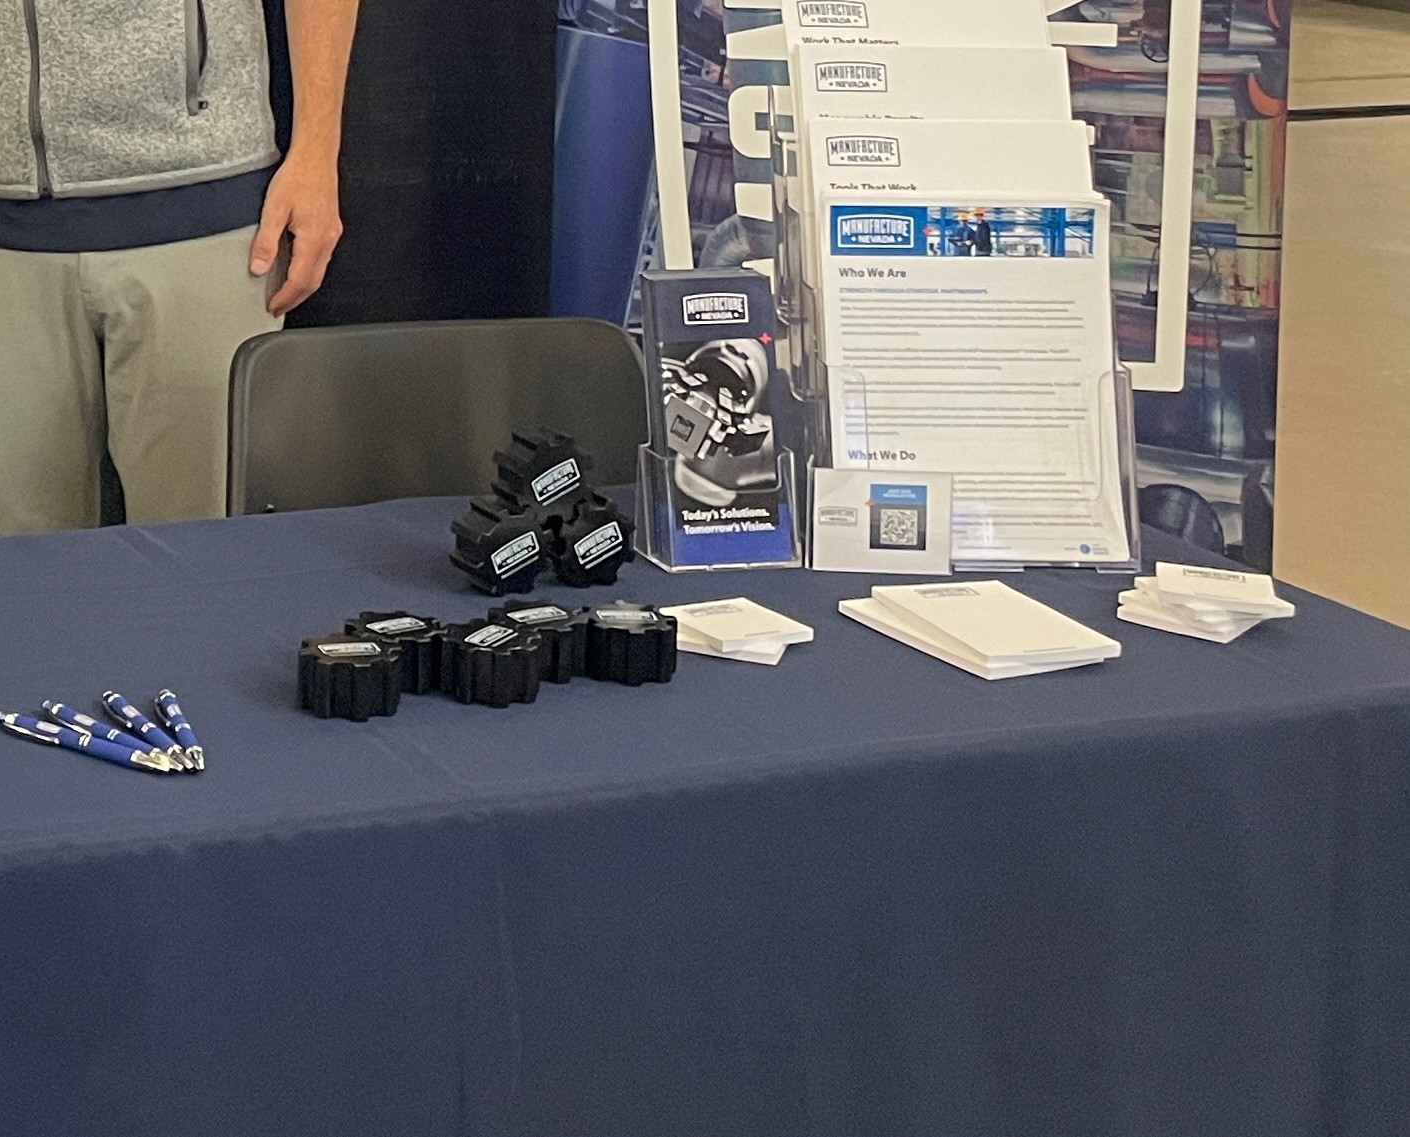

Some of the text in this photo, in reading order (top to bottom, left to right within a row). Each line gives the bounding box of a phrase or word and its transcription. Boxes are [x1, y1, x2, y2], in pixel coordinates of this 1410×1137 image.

[801, 3, 864, 19] MANUFACTURE
[819, 65, 883, 82] MANUFACTURE
[835, 81, 871, 89] NEVADA
[830, 139, 896, 156] MANUFACTURE
[847, 155, 883, 163] NEVADA
[841, 218, 909, 237] MANUFACTURE
[857, 234, 896, 245] NEVADA
[838, 267, 907, 279] Who We Are
[847, 448, 917, 462] What We Do
[681, 507, 771, 522] Today's Solutions.
[682, 520, 777, 536] Tomorrow's Vision.
